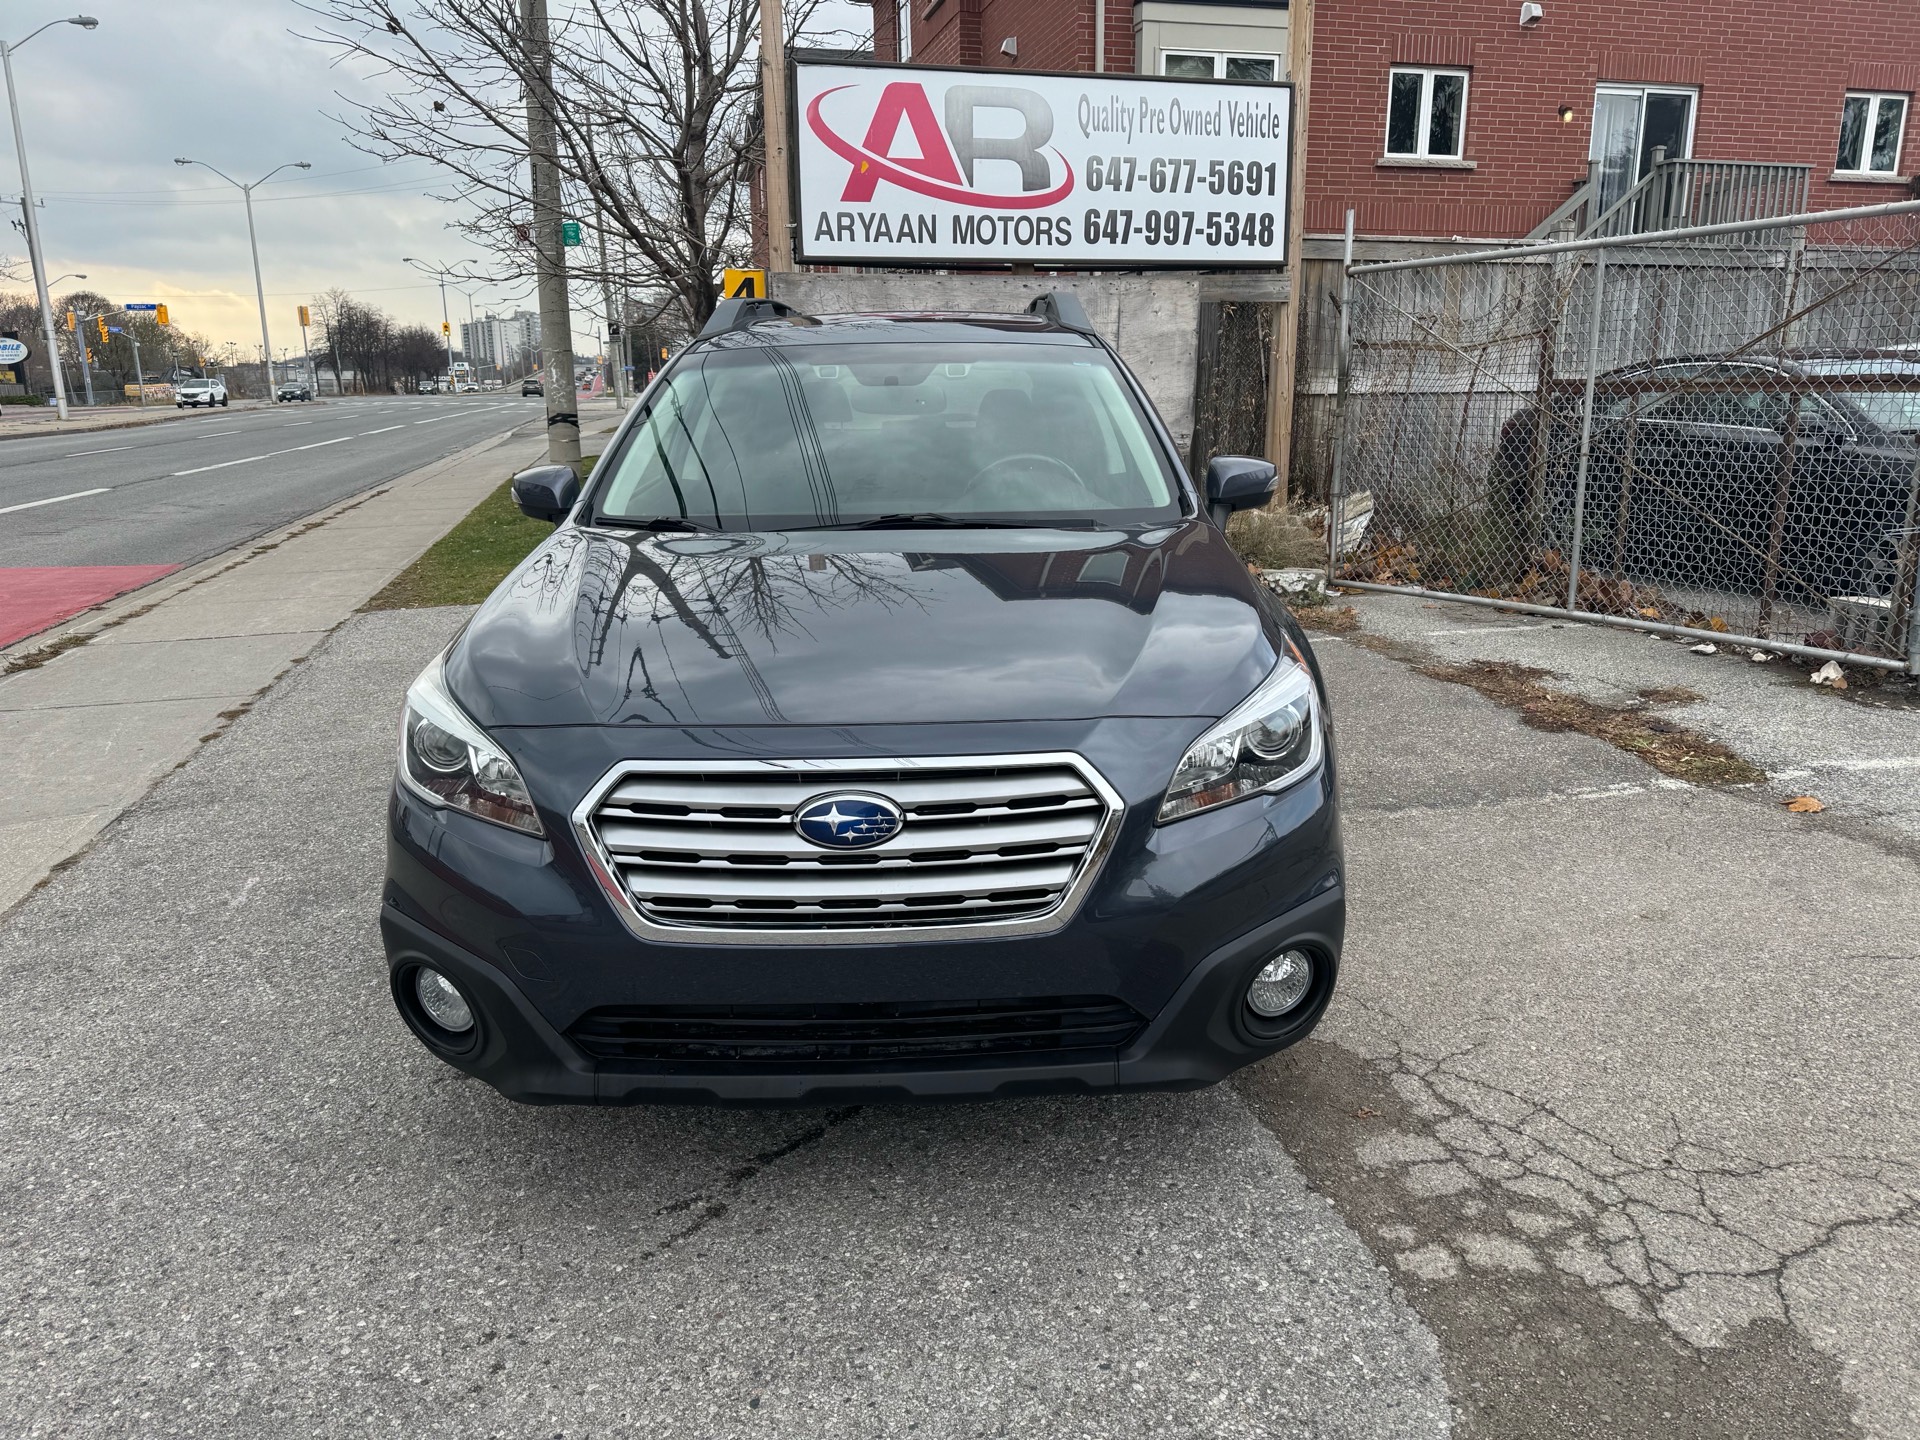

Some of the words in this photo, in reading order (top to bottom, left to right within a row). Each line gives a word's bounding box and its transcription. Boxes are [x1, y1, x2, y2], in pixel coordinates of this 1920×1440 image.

[1077, 93, 1135, 144] Quality
[1139, 96, 1165, 134] Pre
[1169, 97, 1222, 137] Owned
[1227, 100, 1280, 139] Vehicle
[840, 81, 1054, 203] AR
[1086, 155, 1277, 196] 647-677-5691
[814, 211, 937, 244] ARYAAN
[952, 214, 1072, 246] MOTORS
[1083, 208, 1275, 247] 647-997-5348
